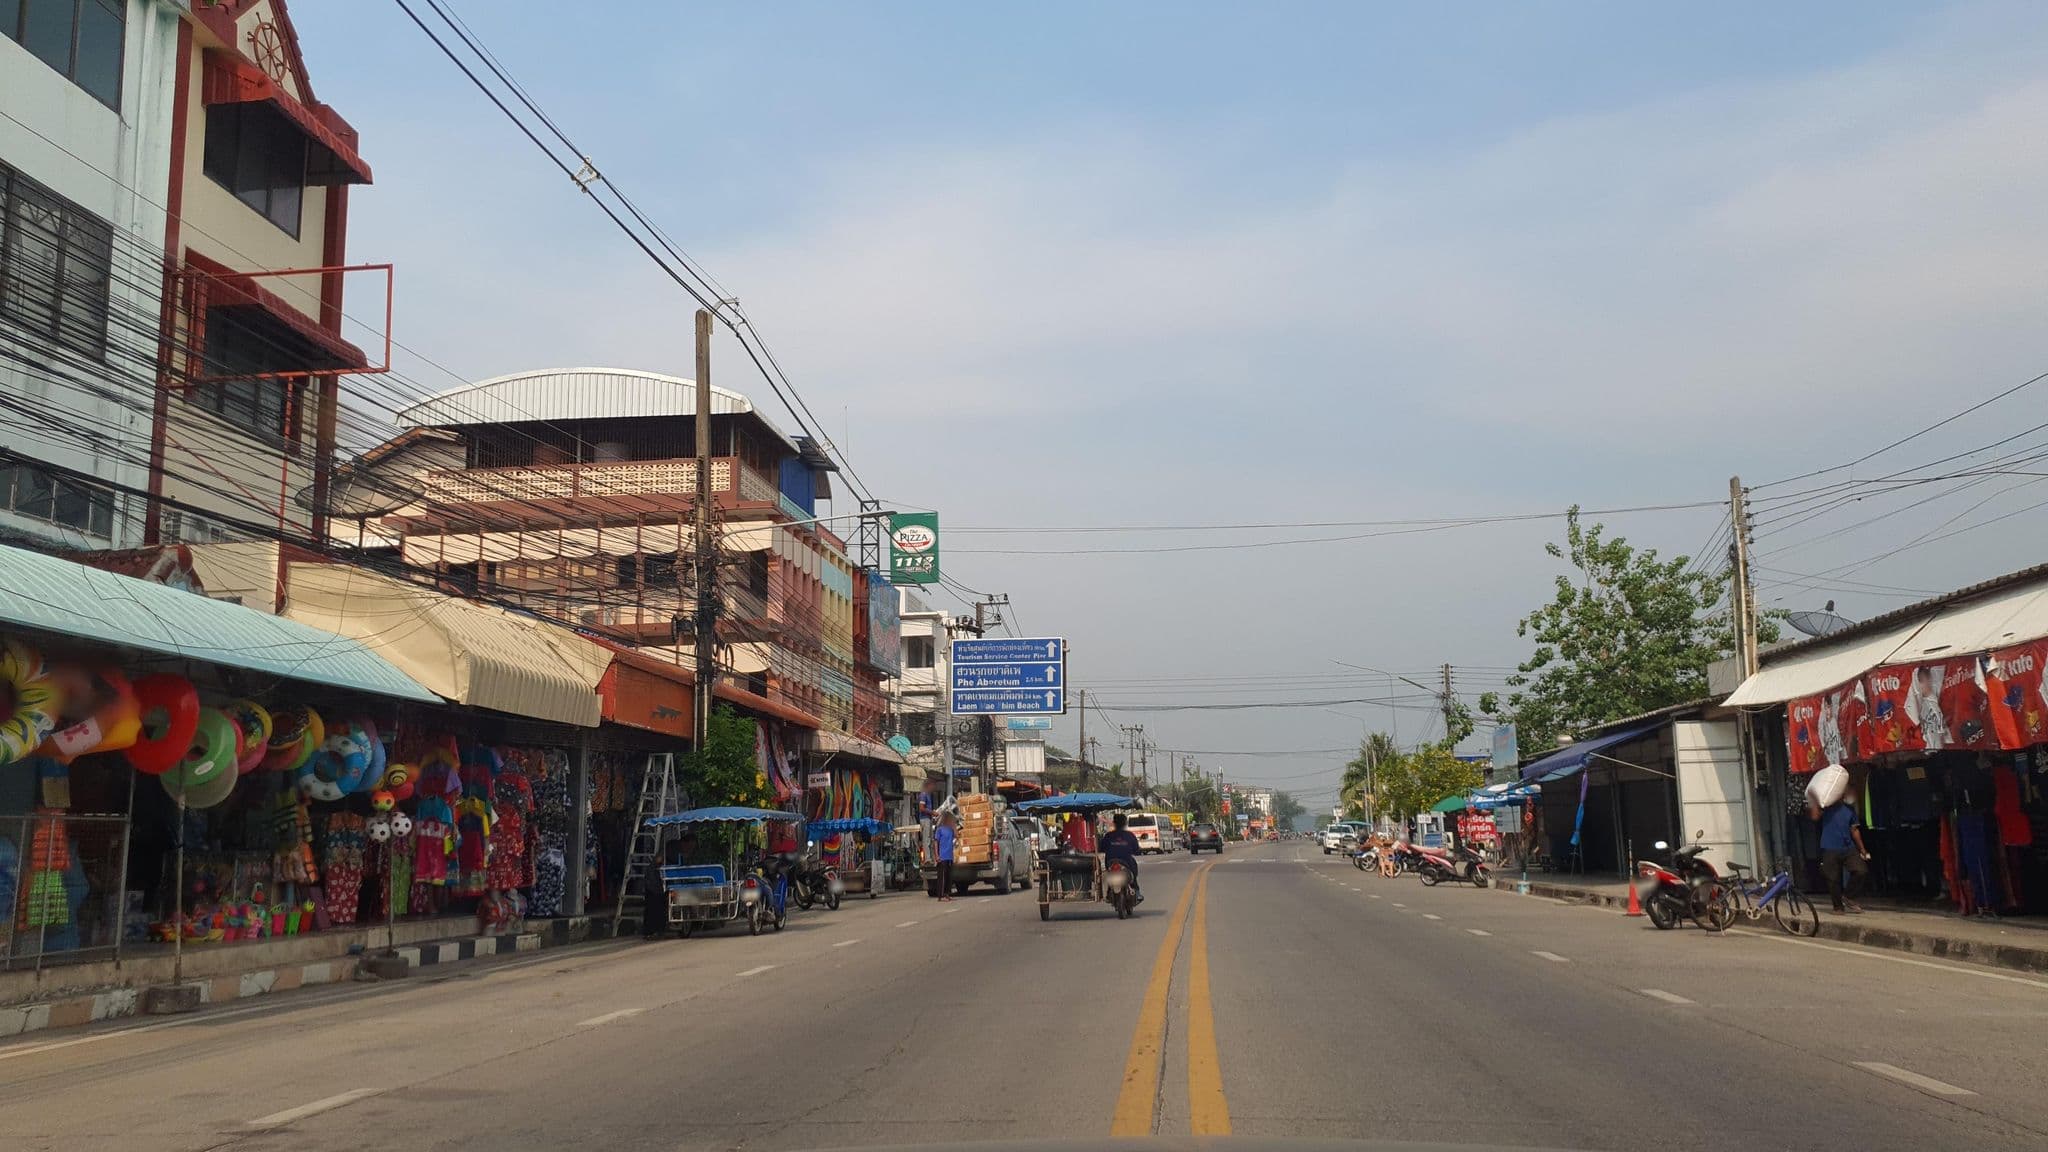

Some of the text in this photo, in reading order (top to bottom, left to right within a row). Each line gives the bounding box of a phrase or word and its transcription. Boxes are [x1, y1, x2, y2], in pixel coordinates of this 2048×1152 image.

[900, 533, 928, 542] PIZZA
[2008, 654, 2033, 677] Kito
[957, 678, 974, 687] Phe
[976, 678, 1020, 686] Aboretum
[957, 702, 977, 710] Laem
[1017, 701, 1040, 709] Beach
